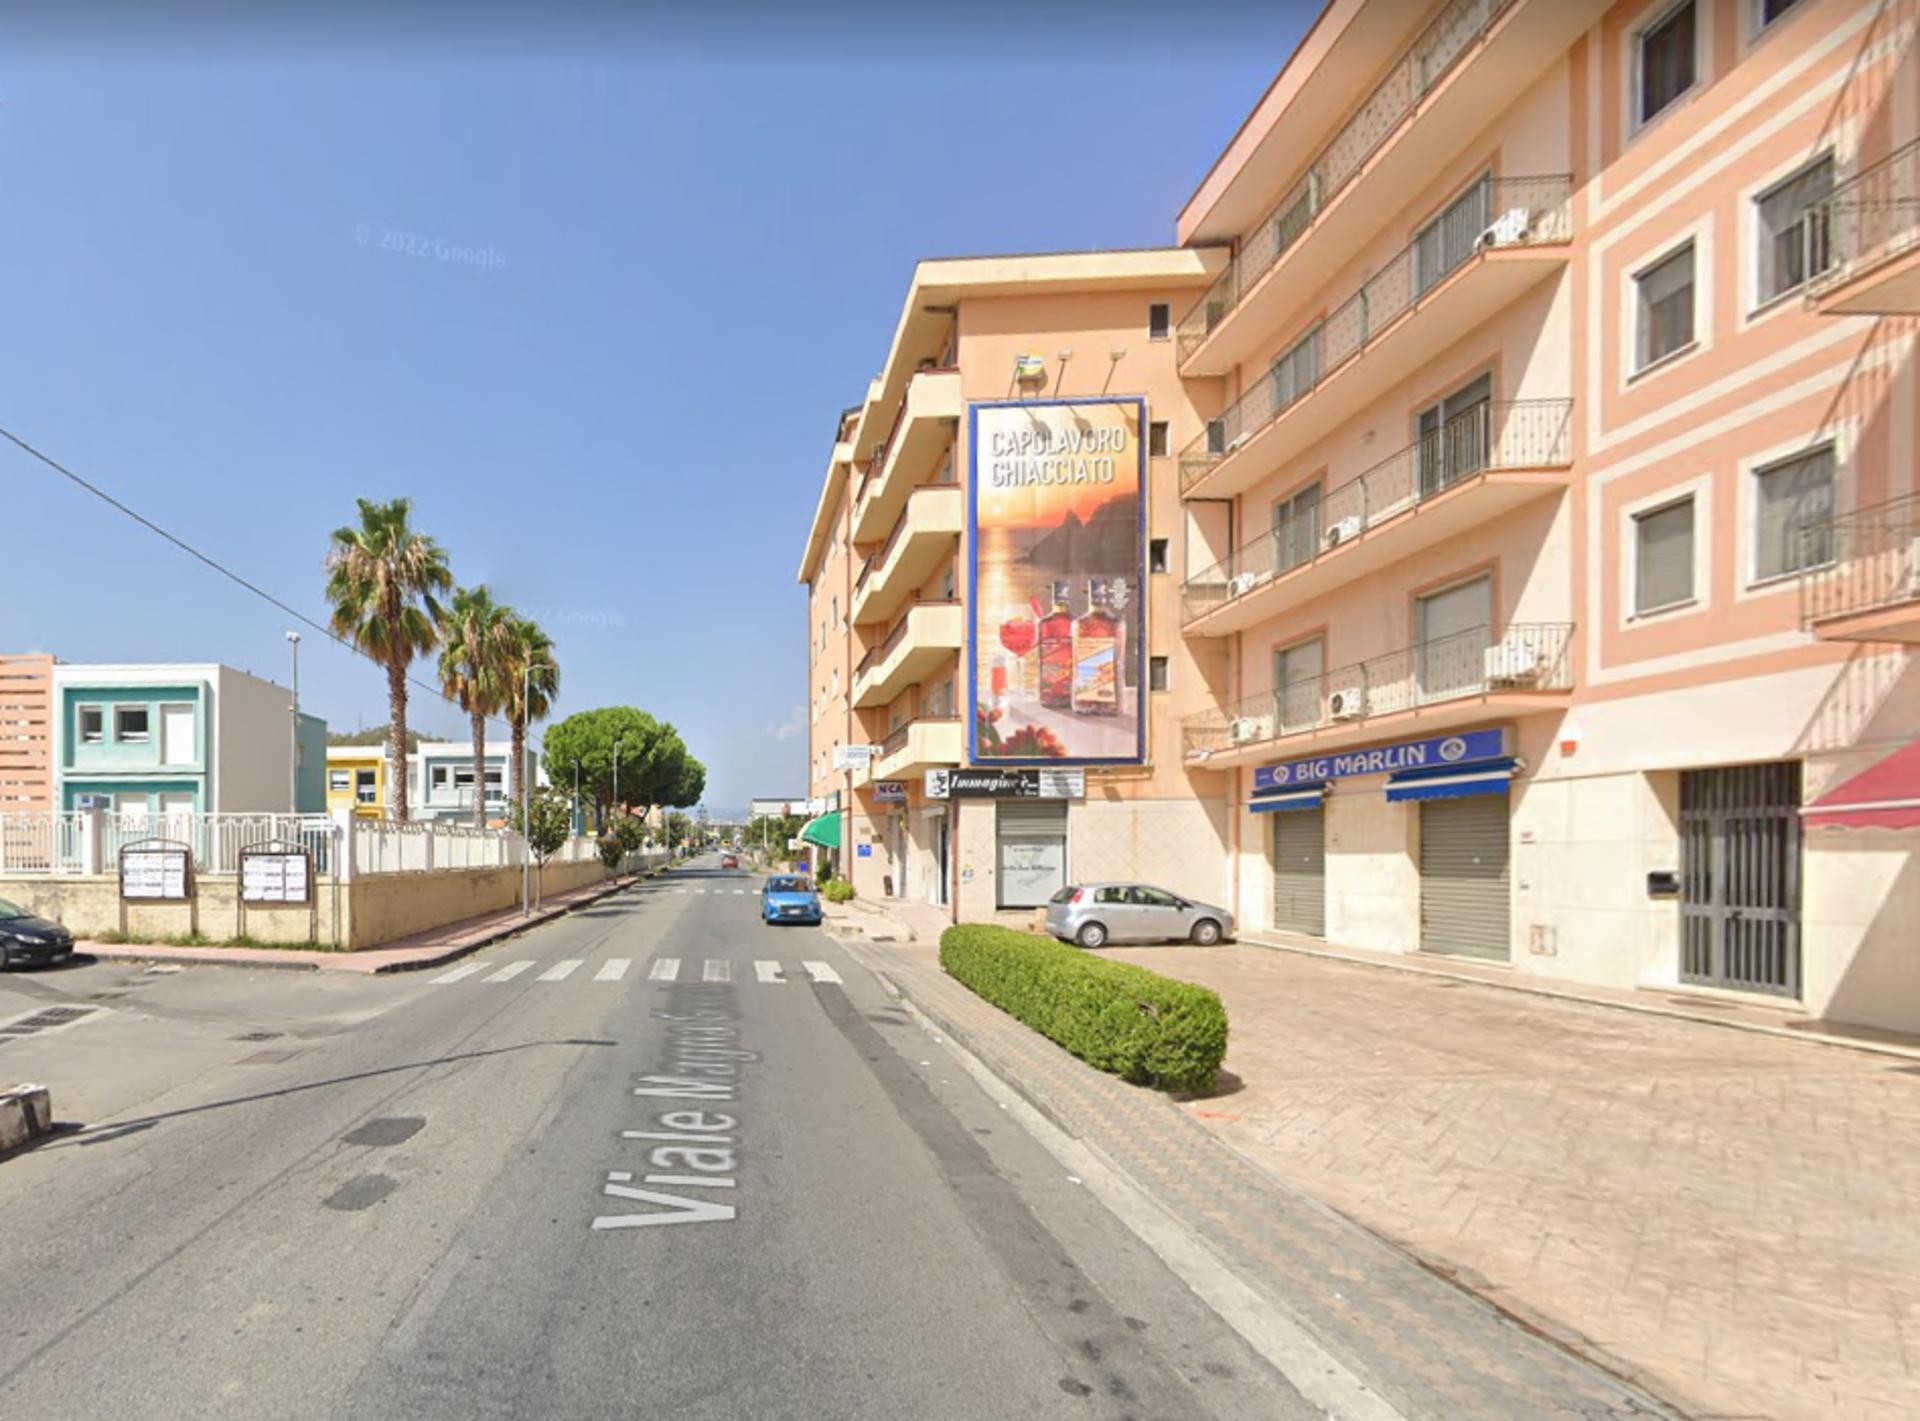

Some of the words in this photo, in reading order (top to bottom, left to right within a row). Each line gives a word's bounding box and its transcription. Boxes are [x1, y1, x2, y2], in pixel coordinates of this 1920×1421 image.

[992, 426, 1126, 457] CAPOLAVORO
[1295, 759, 1328, 781] BIG
[1334, 743, 1426, 775] MARLIN
